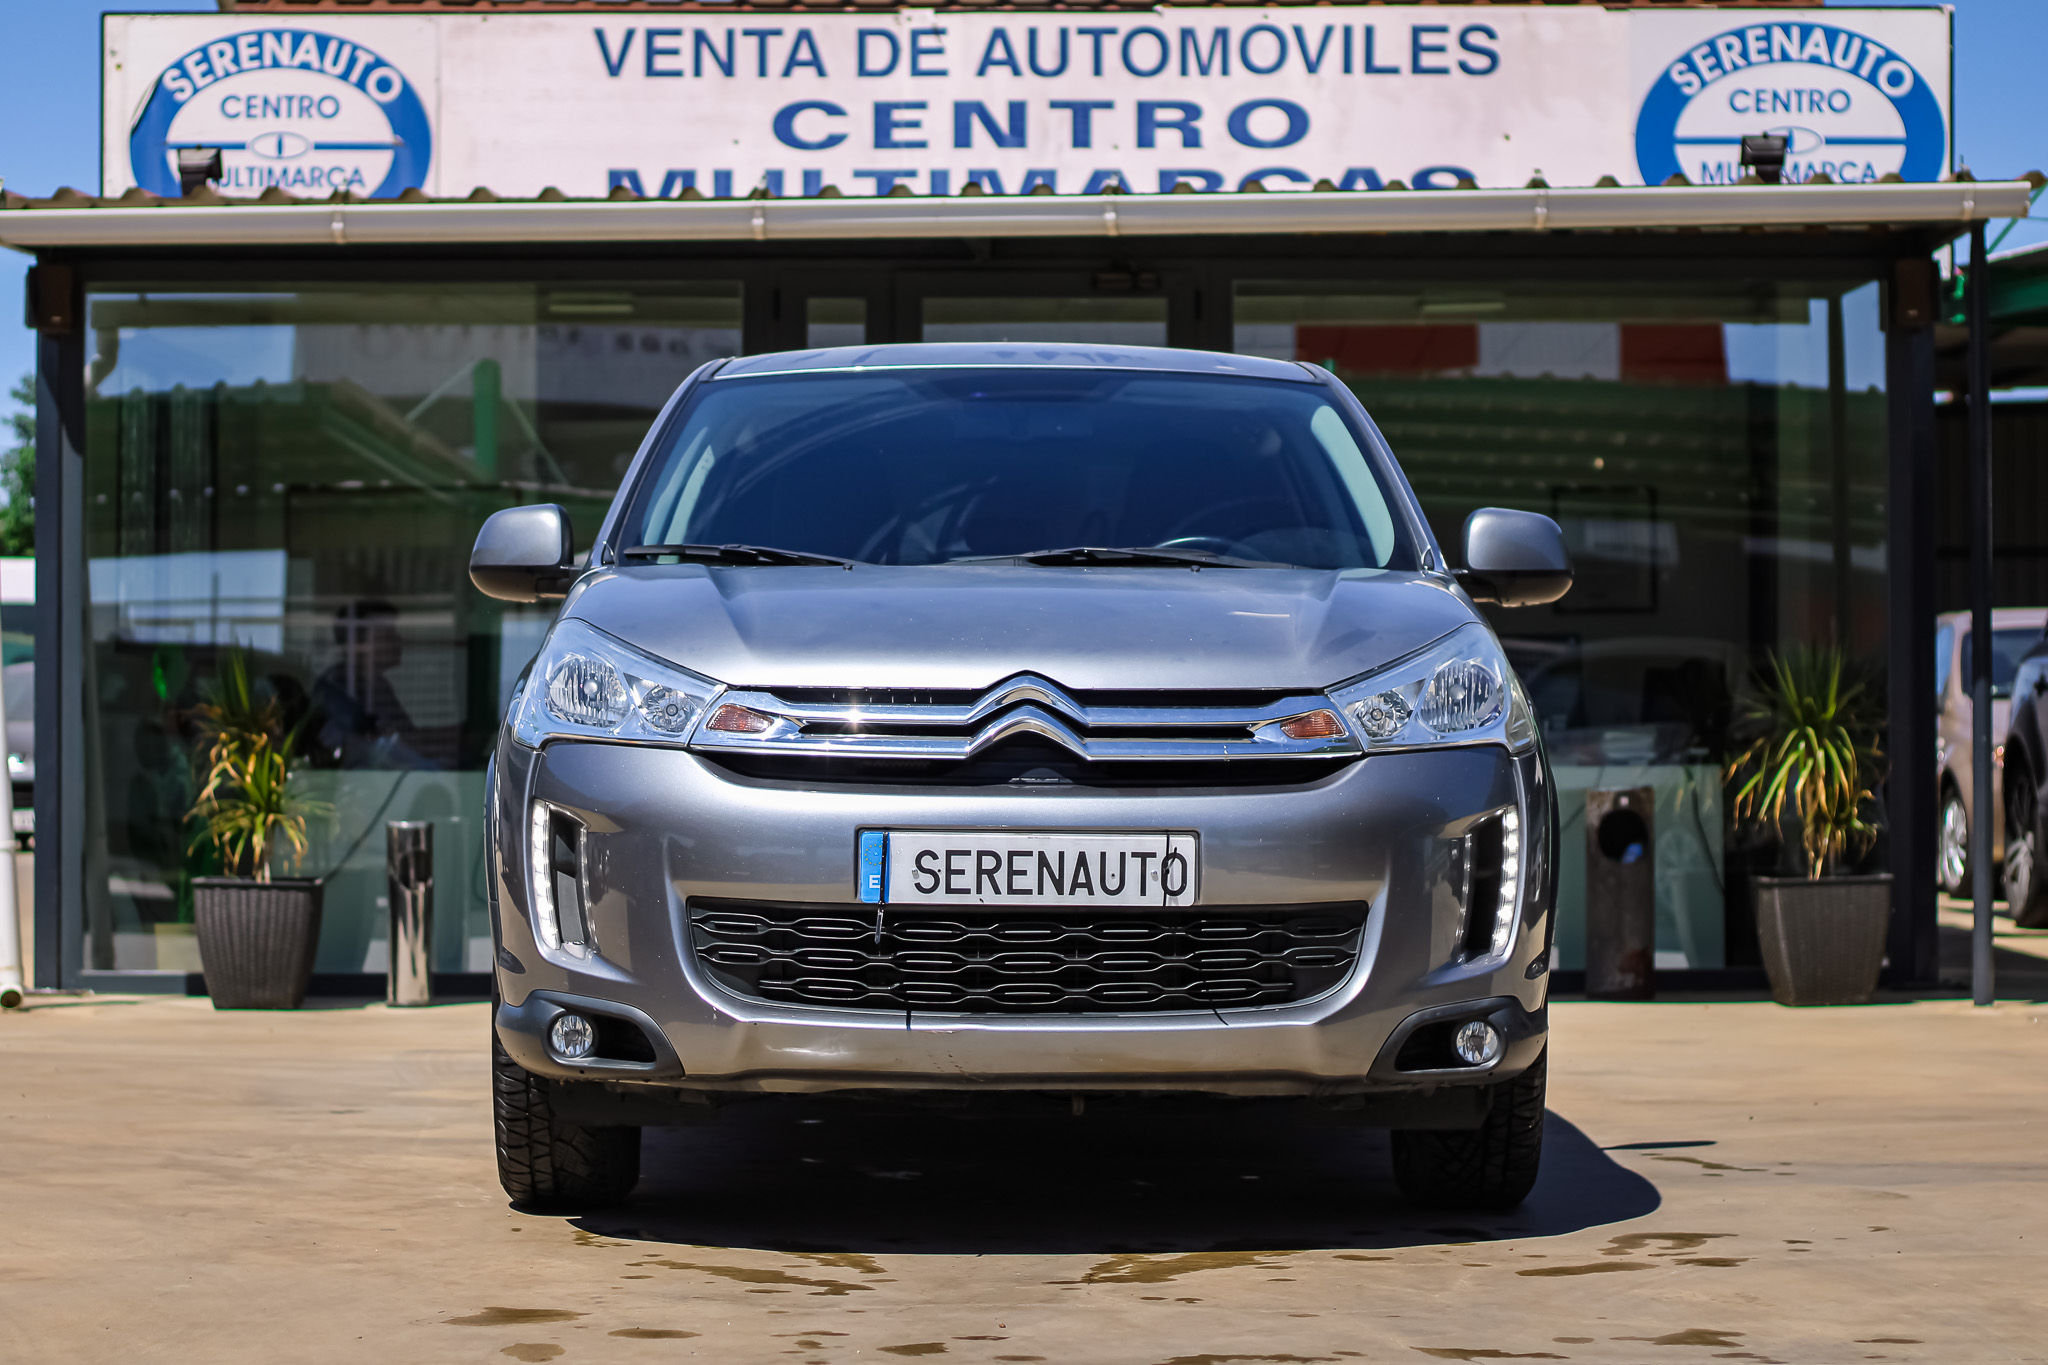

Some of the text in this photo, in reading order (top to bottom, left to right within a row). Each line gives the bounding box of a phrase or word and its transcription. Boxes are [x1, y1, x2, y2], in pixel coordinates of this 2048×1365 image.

[162, 31, 404, 103] SERENAUTO
[594, 23, 1501, 78] VENTA DE AUTOMOVILES
[1669, 25, 1915, 98] SERENAUTO
[220, 95, 341, 119] CENTRO
[772, 98, 1311, 151] CENTRO
[1729, 88, 1851, 114] CENTRO
[210, 165, 366, 188] ULTIMARCA
[869, 874, 881, 889] E
[913, 849, 1188, 897] SERENAUTO
